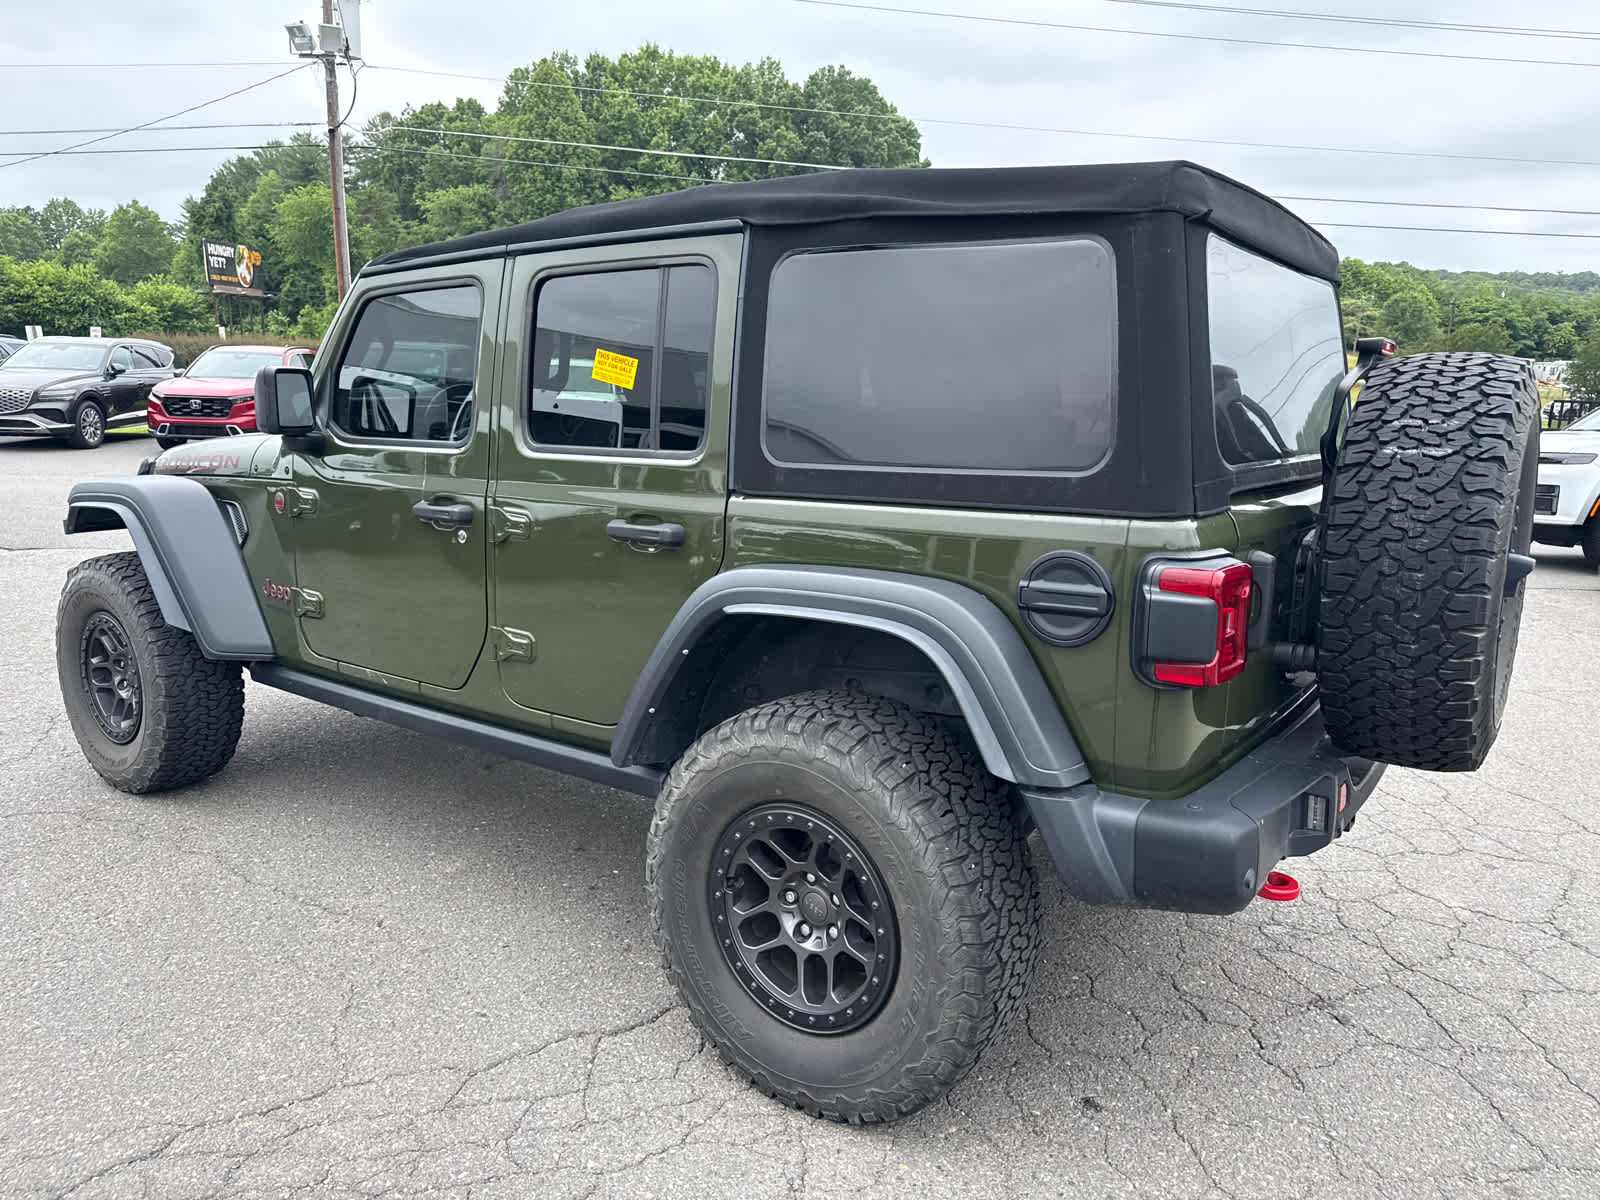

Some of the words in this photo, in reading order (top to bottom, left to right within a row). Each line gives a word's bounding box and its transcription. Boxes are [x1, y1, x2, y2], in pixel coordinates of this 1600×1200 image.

[207, 242, 235, 258] HUNGRY
[208, 256, 227, 269] YET?
[598, 351, 610, 361] THIS
[611, 355, 635, 368] VEHICLE
[608, 362, 618, 370] FOR
[619, 365, 633, 374] SALE
[157, 454, 241, 471] RUBICON
[262, 577, 292, 605] Jeep
